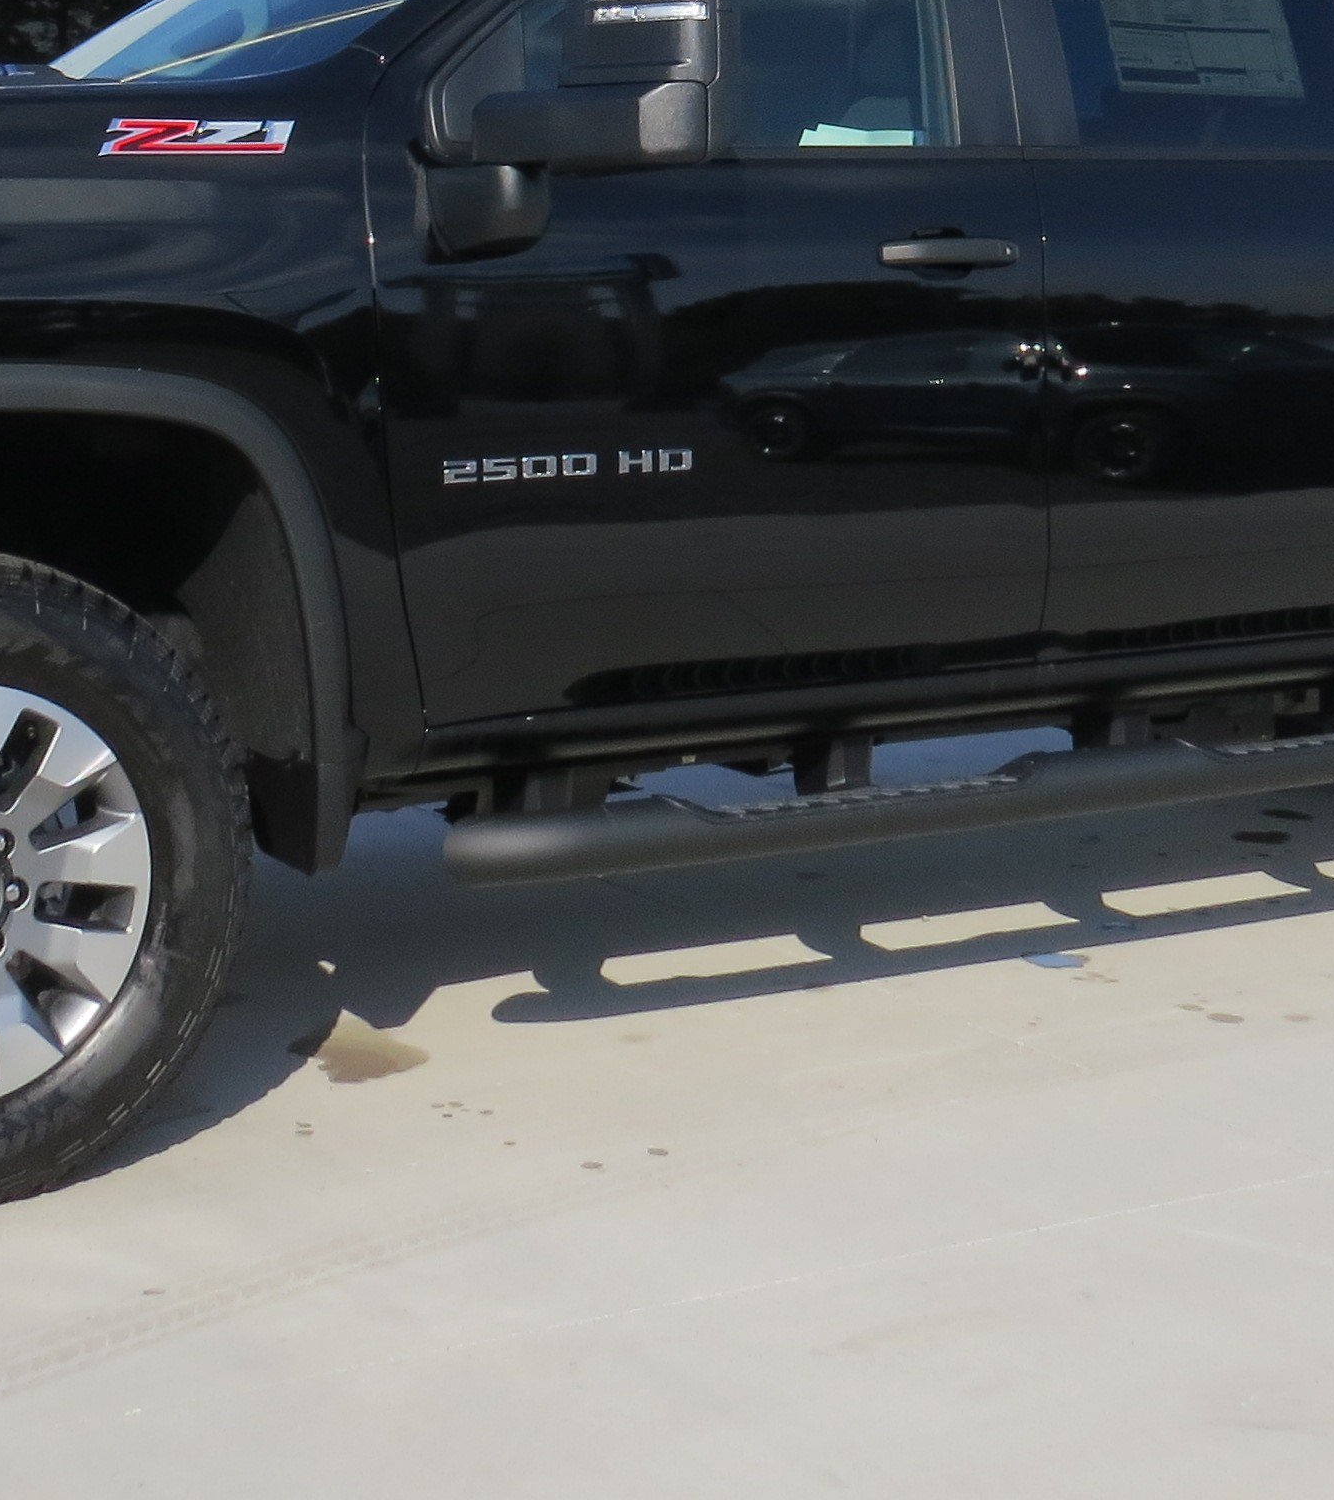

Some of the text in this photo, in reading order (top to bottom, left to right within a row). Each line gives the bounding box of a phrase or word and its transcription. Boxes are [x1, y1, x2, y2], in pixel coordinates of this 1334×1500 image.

[98, 117, 296, 157] Z71
[442, 448, 693, 485] 2500 HD
